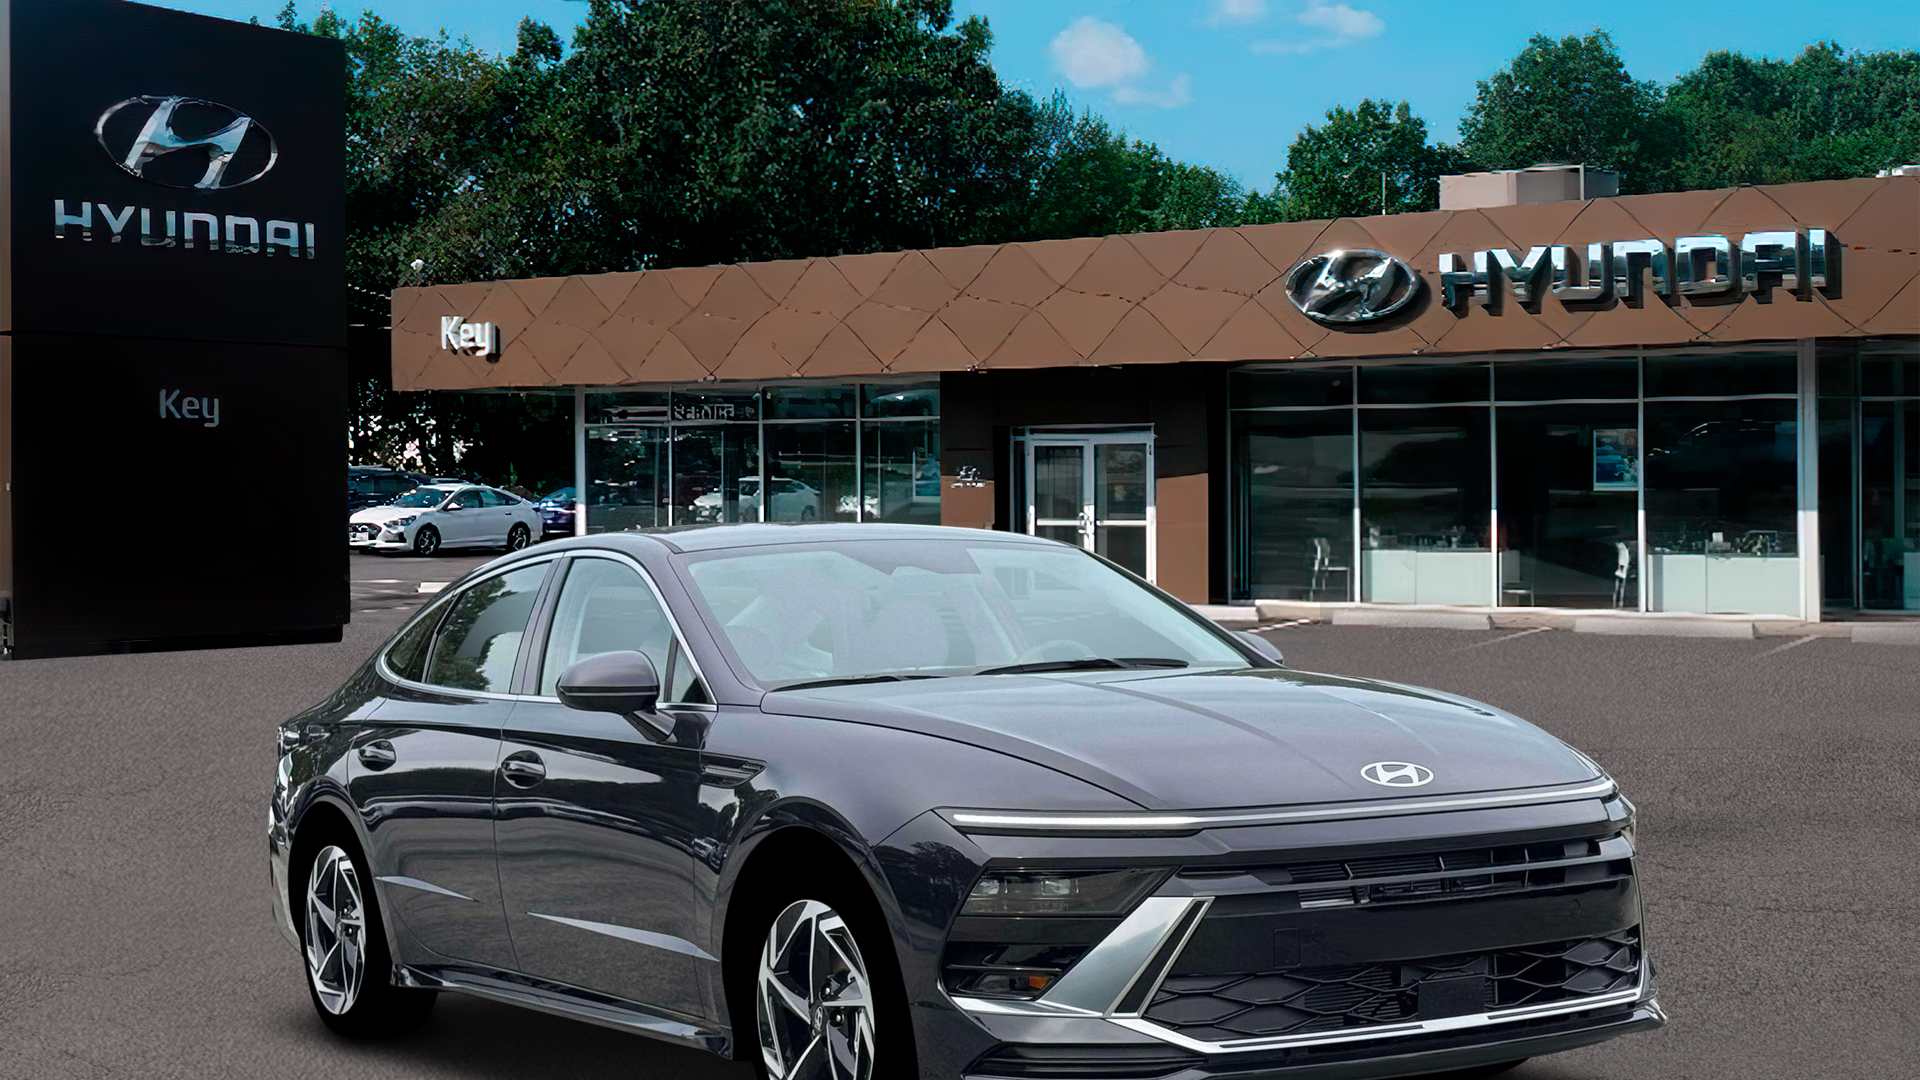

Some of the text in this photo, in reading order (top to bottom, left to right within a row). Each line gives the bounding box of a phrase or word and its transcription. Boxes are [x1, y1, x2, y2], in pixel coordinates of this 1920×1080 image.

[54, 199, 315, 259] HYUNDAI
[1438, 229, 1834, 314] HYUNDAI
[441, 315, 493, 357] Key
[159, 388, 219, 427] Key
